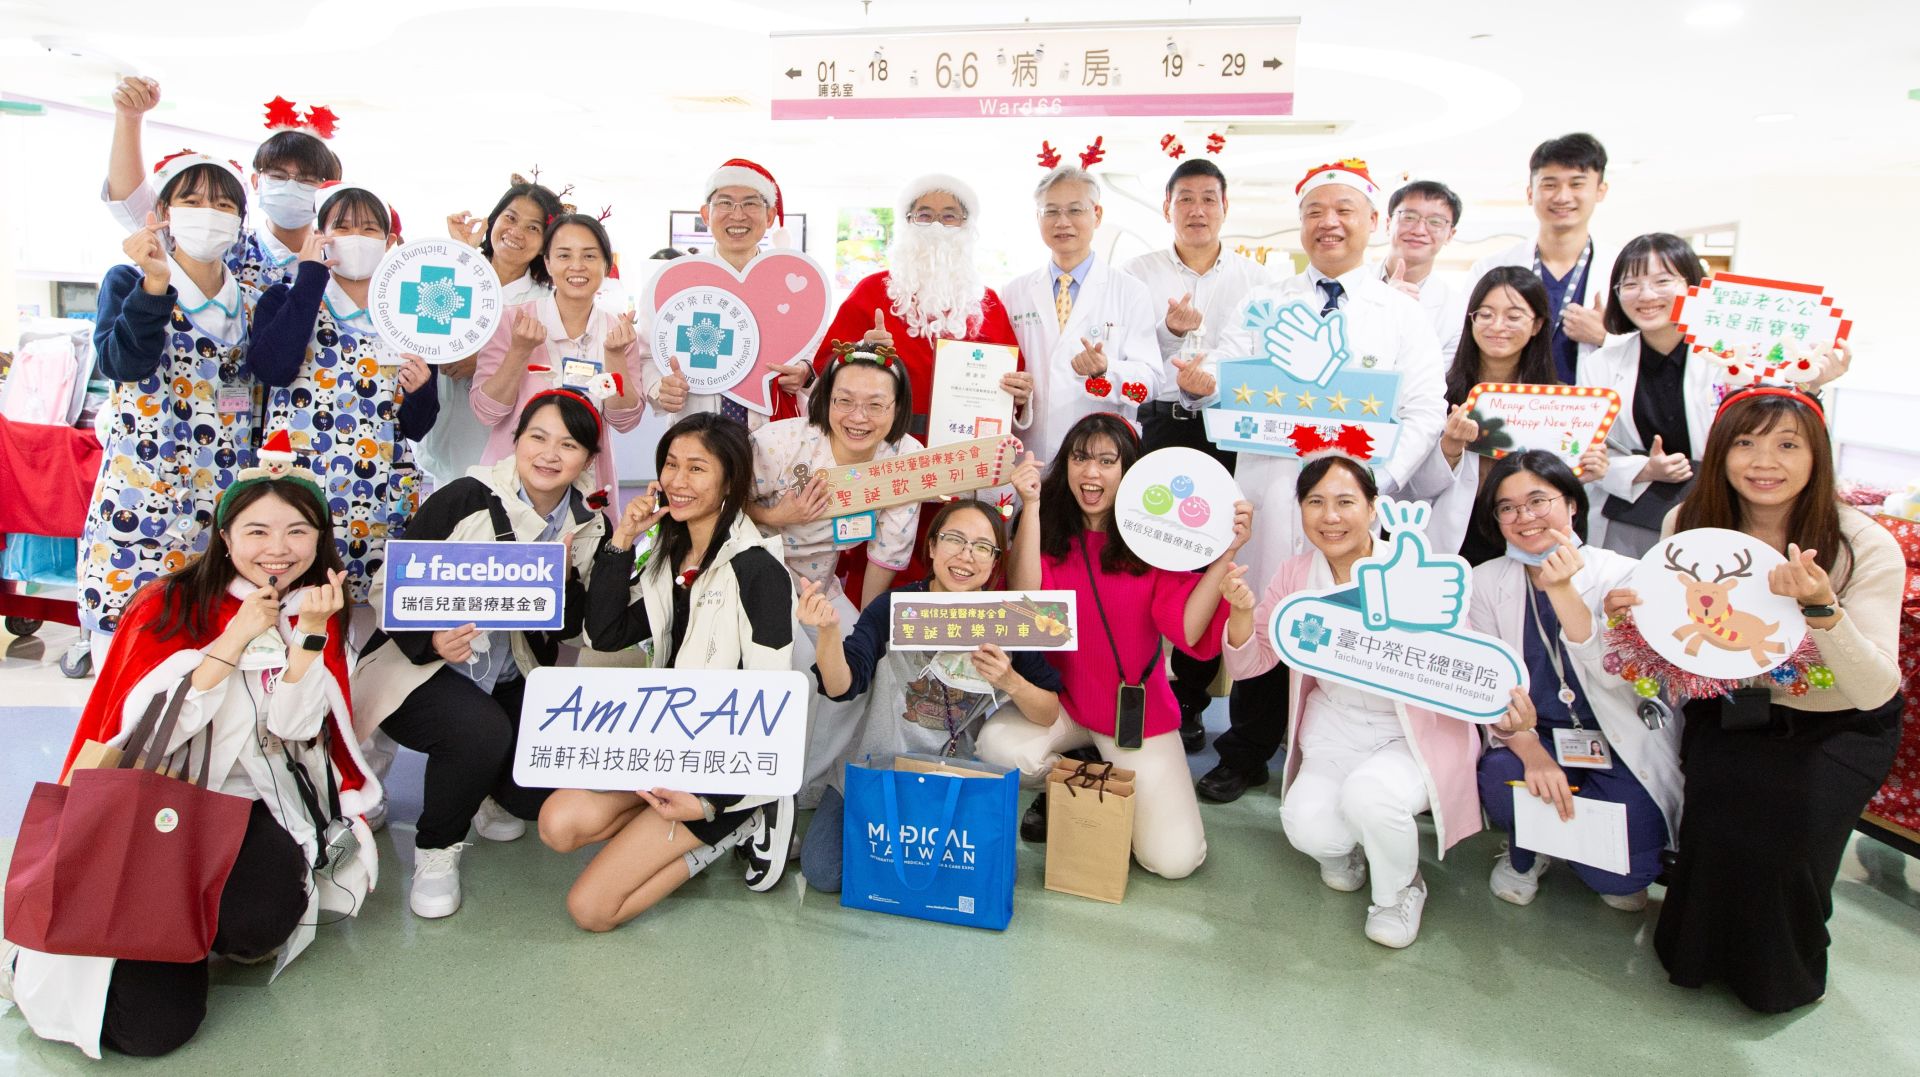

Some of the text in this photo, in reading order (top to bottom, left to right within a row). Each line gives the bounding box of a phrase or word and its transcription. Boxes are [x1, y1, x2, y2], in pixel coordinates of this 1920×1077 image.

[817, 61, 837, 82] 01
[868, 59, 888, 81] 18
[935, 48, 1111, 88] 66 病房
[1162, 54, 1184, 77] 19
[1221, 53, 1246, 77] 29
[378, 245, 448, 356] Taichung Veterans General Hospital
[1712, 286, 1817, 317] 聖誕老公公
[1704, 309, 1811, 341] 我是乖寶寶
[707, 368, 737, 386] General
[735, 337, 751, 369] Hospital
[868, 445, 981, 478] 瑞信兒童醫療基金會
[836, 461, 990, 507] 聖誕歡樂列車
[1123, 519, 1214, 557] 瑞信兒童醫療基金會
[429, 554, 554, 582] facebook
[401, 596, 547, 612] 瑞信兒童醫療基金會
[920, 607, 1007, 620] 瑞信兒童醫療基金會
[902, 623, 1031, 641] 聖誕歡樂列車
[1336, 628, 1500, 690] 臺中榮民總醫院
[1334, 650, 1494, 703] Taichung Veterans General Hospital
[538, 685, 791, 740] AmTRAN
[529, 745, 779, 776] 瑞軒科技股份有限公司
[869, 840, 975, 864] TAIWAN
